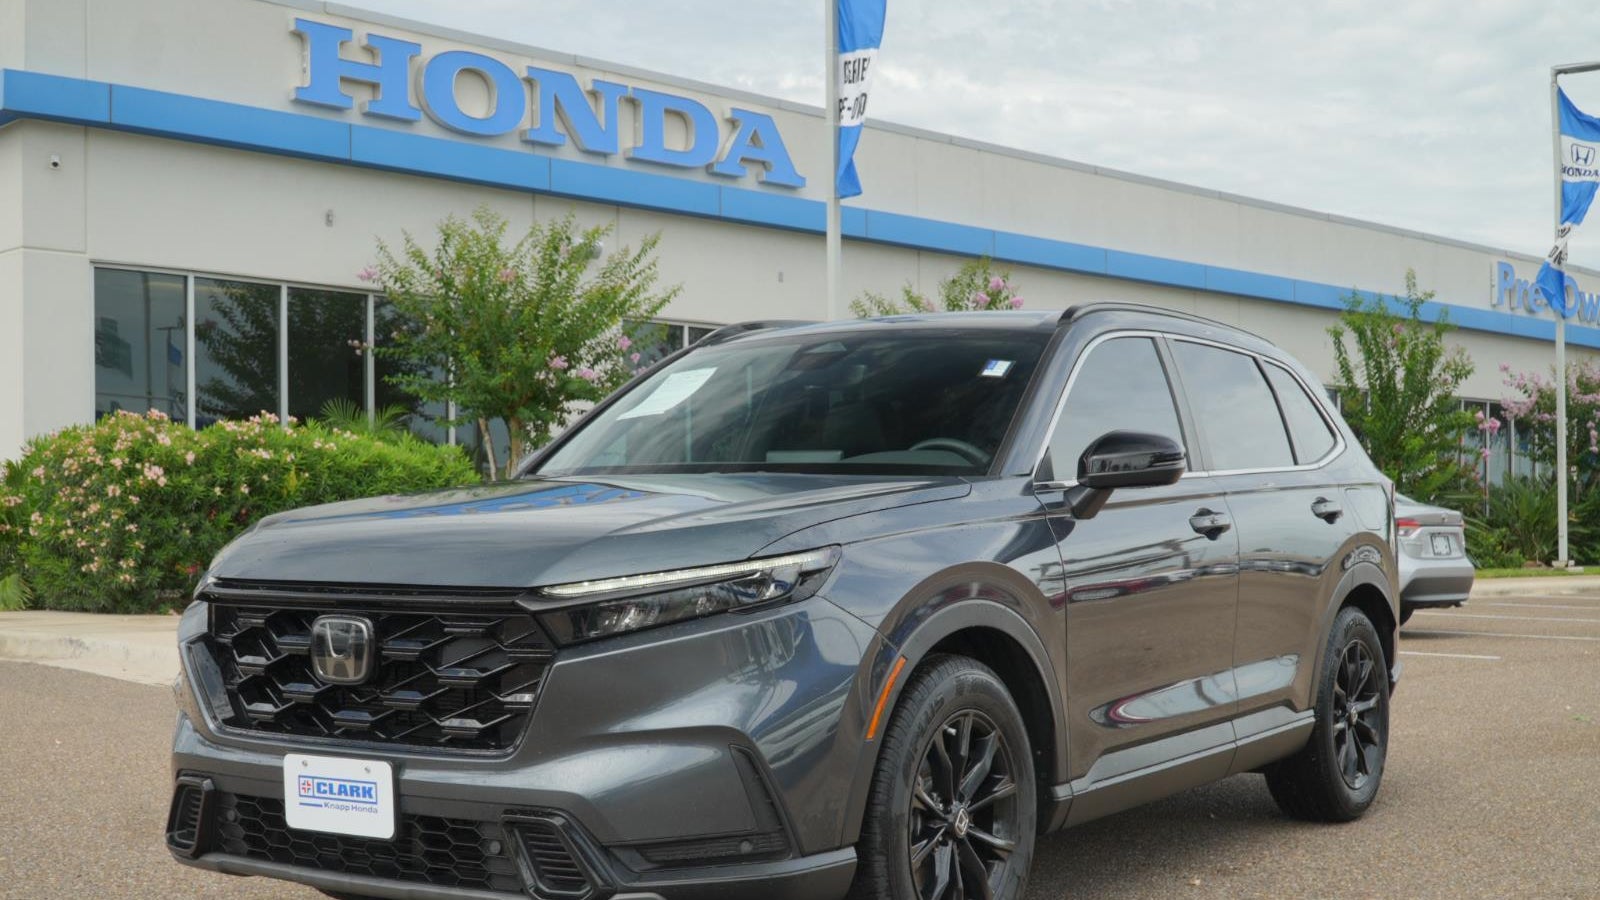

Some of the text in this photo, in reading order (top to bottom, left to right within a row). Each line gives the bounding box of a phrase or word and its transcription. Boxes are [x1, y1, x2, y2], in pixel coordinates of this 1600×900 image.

[292, 17, 806, 188] HONDA
[316, 781, 373, 799] CLARK
[324, 802, 378, 814] Knapp Honda
